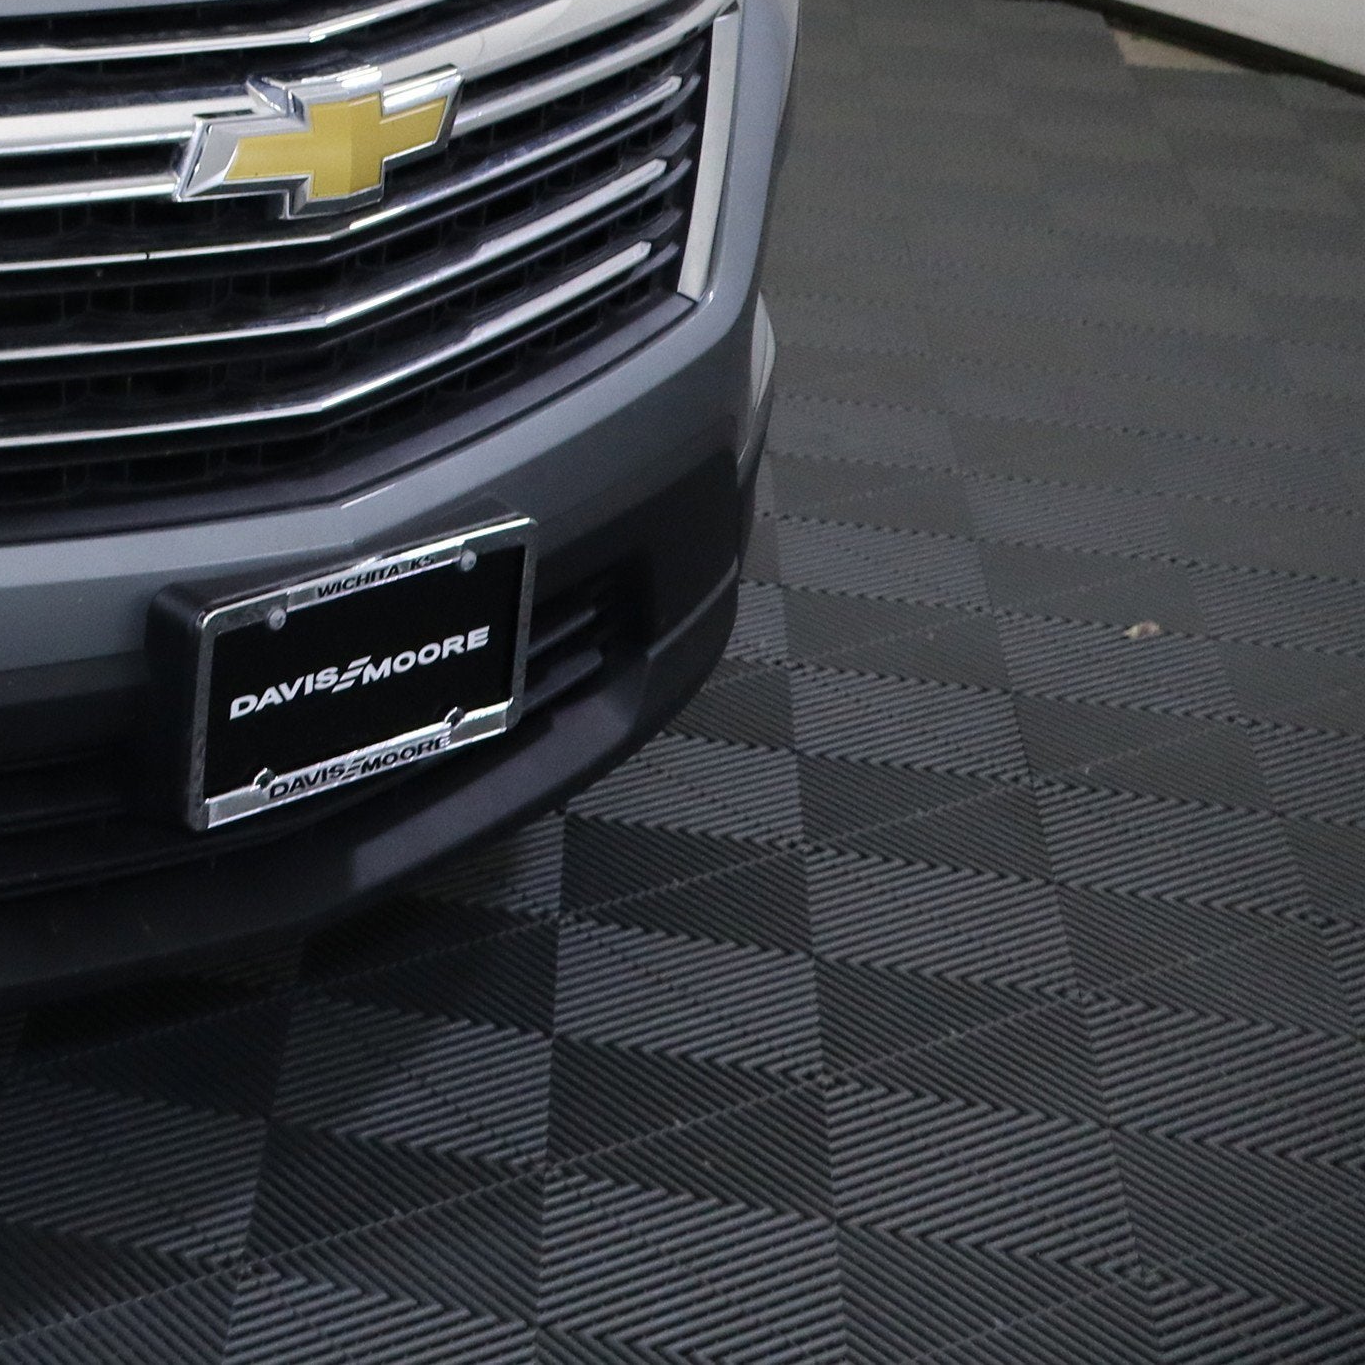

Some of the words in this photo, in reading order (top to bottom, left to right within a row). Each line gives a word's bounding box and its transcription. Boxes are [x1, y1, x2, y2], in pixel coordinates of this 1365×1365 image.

[229, 667, 340, 721] DAVIS
[361, 625, 490, 686] MOORE
[270, 763, 346, 799] DAVIS
[361, 734, 452, 775] MOORE
